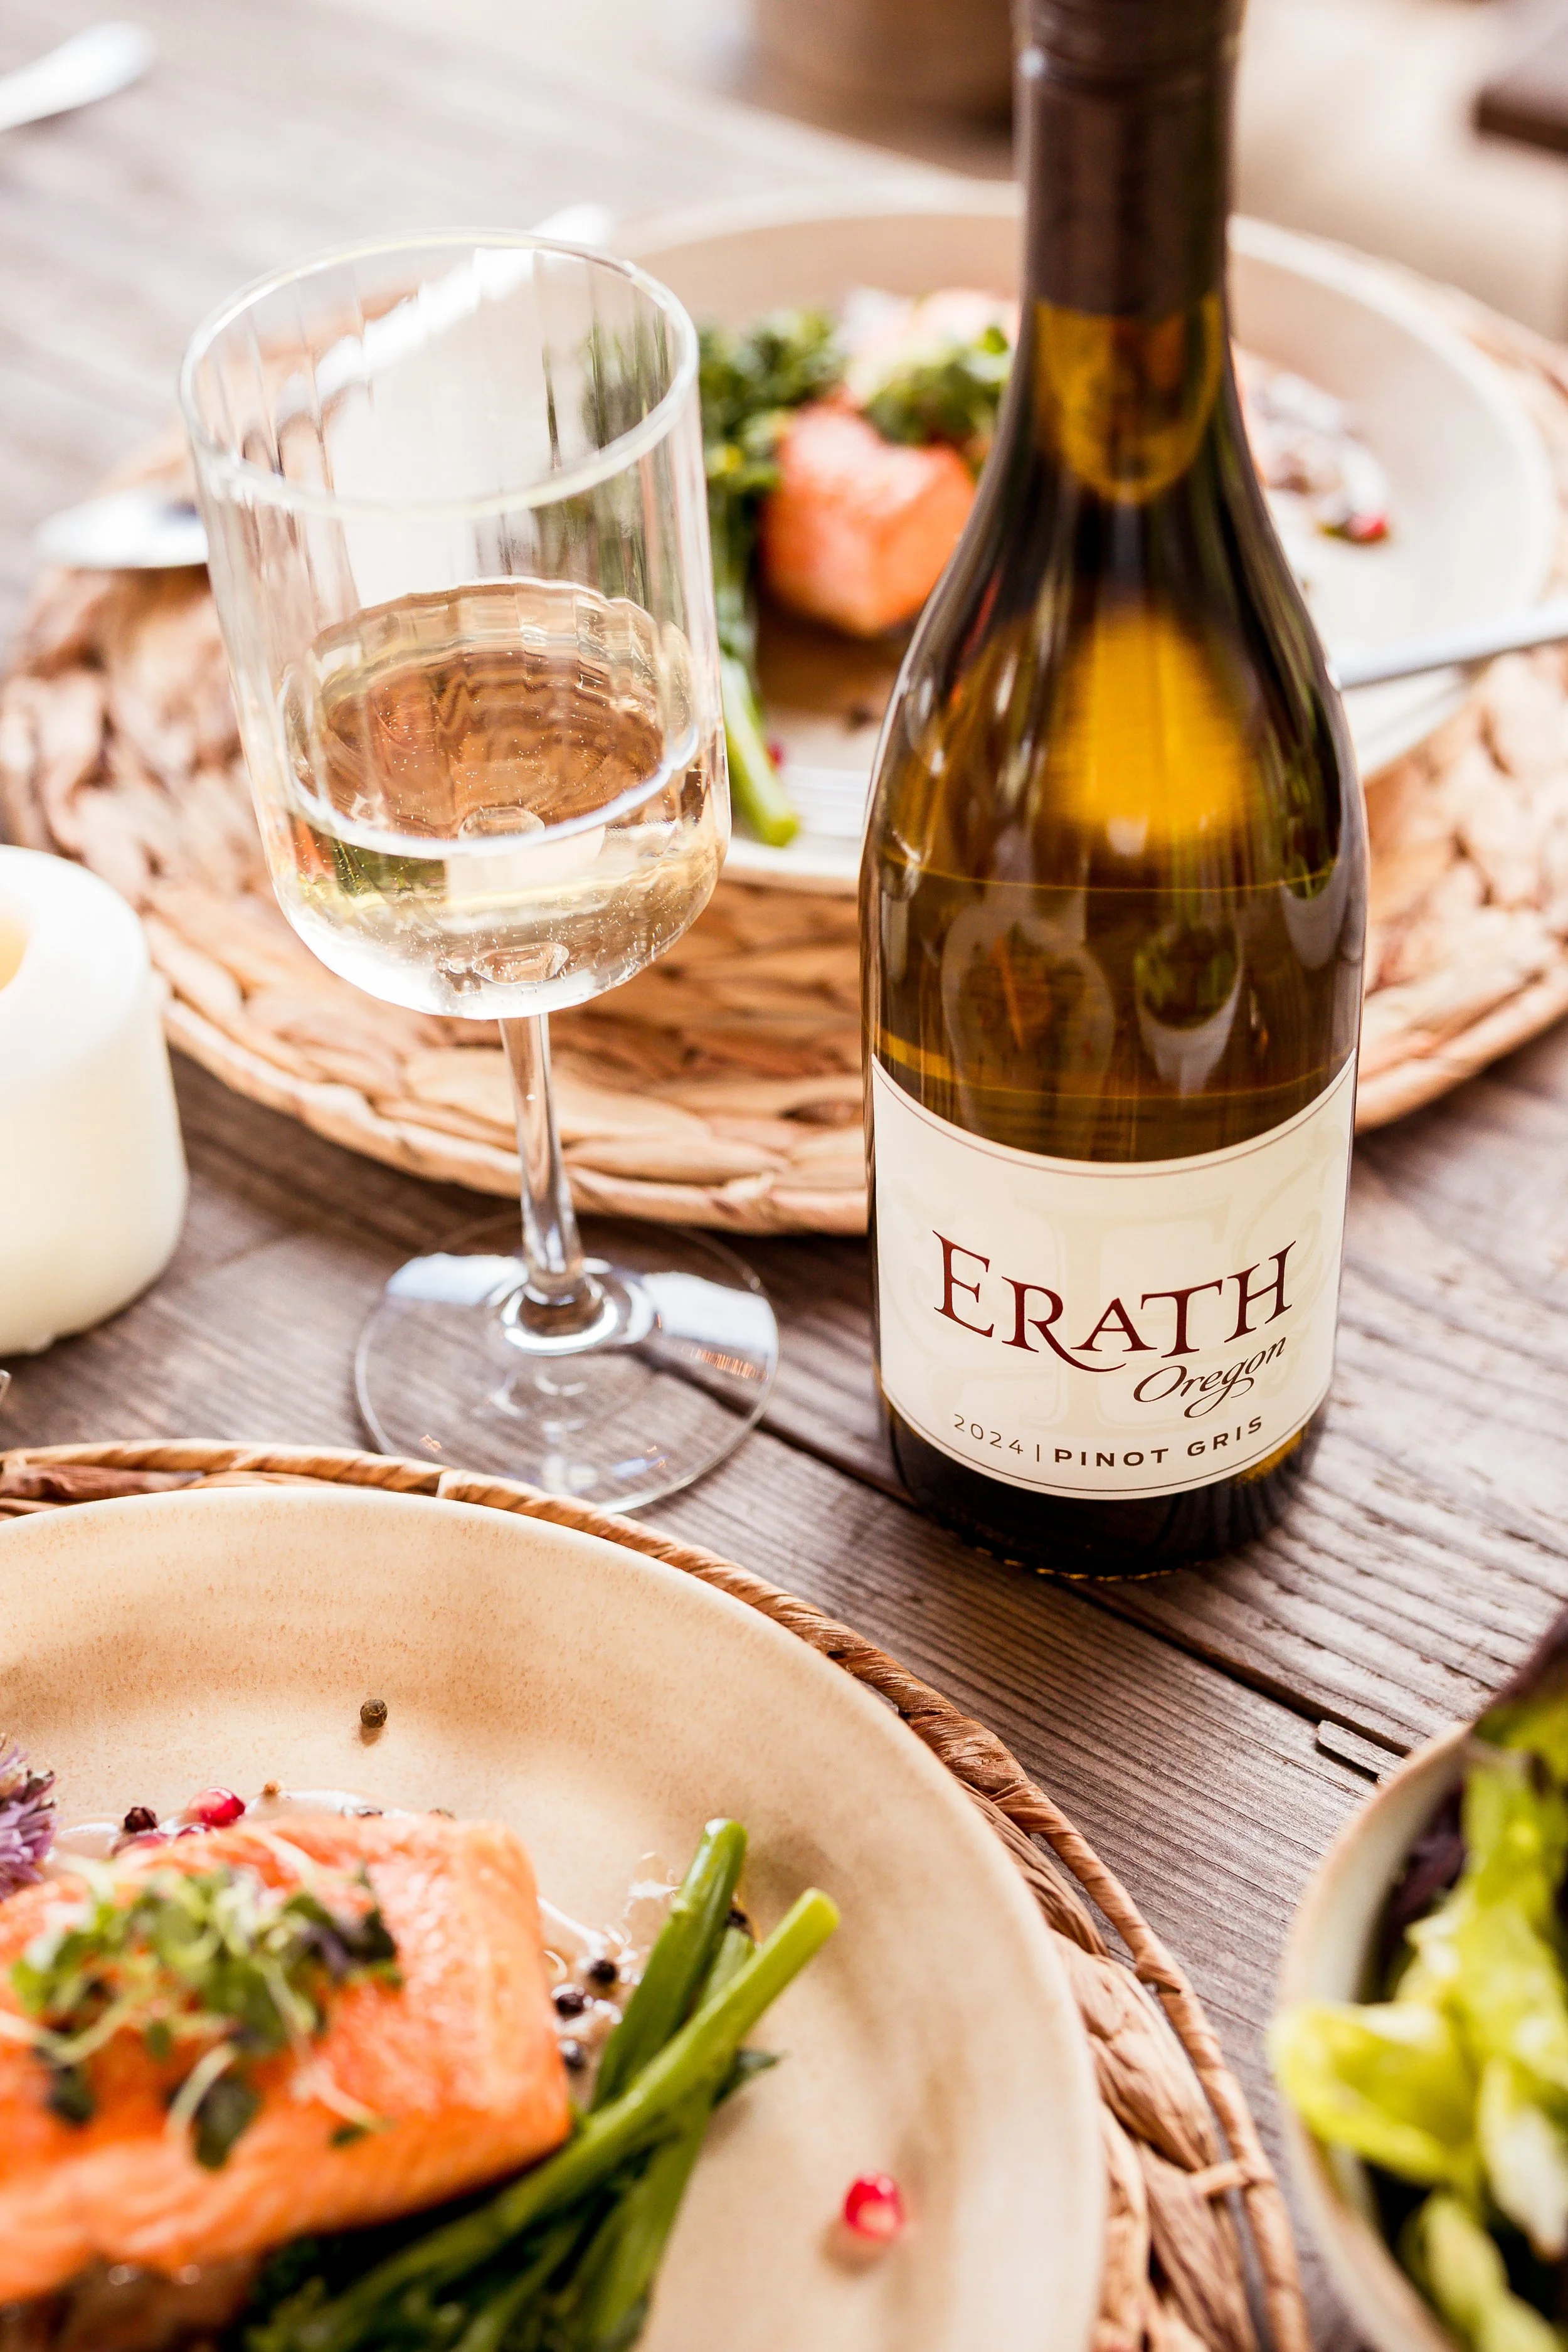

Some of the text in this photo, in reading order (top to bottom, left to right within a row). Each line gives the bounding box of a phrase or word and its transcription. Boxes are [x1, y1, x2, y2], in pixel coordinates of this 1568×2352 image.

[932, 1229, 1296, 1373] ERATH
[1133, 1337, 1286, 1418] Oregon
[953, 1413, 1024, 1455] 2024
[1054, 1447, 1170, 1468] PINOT
[1187, 1416, 1262, 1457] GRIS
